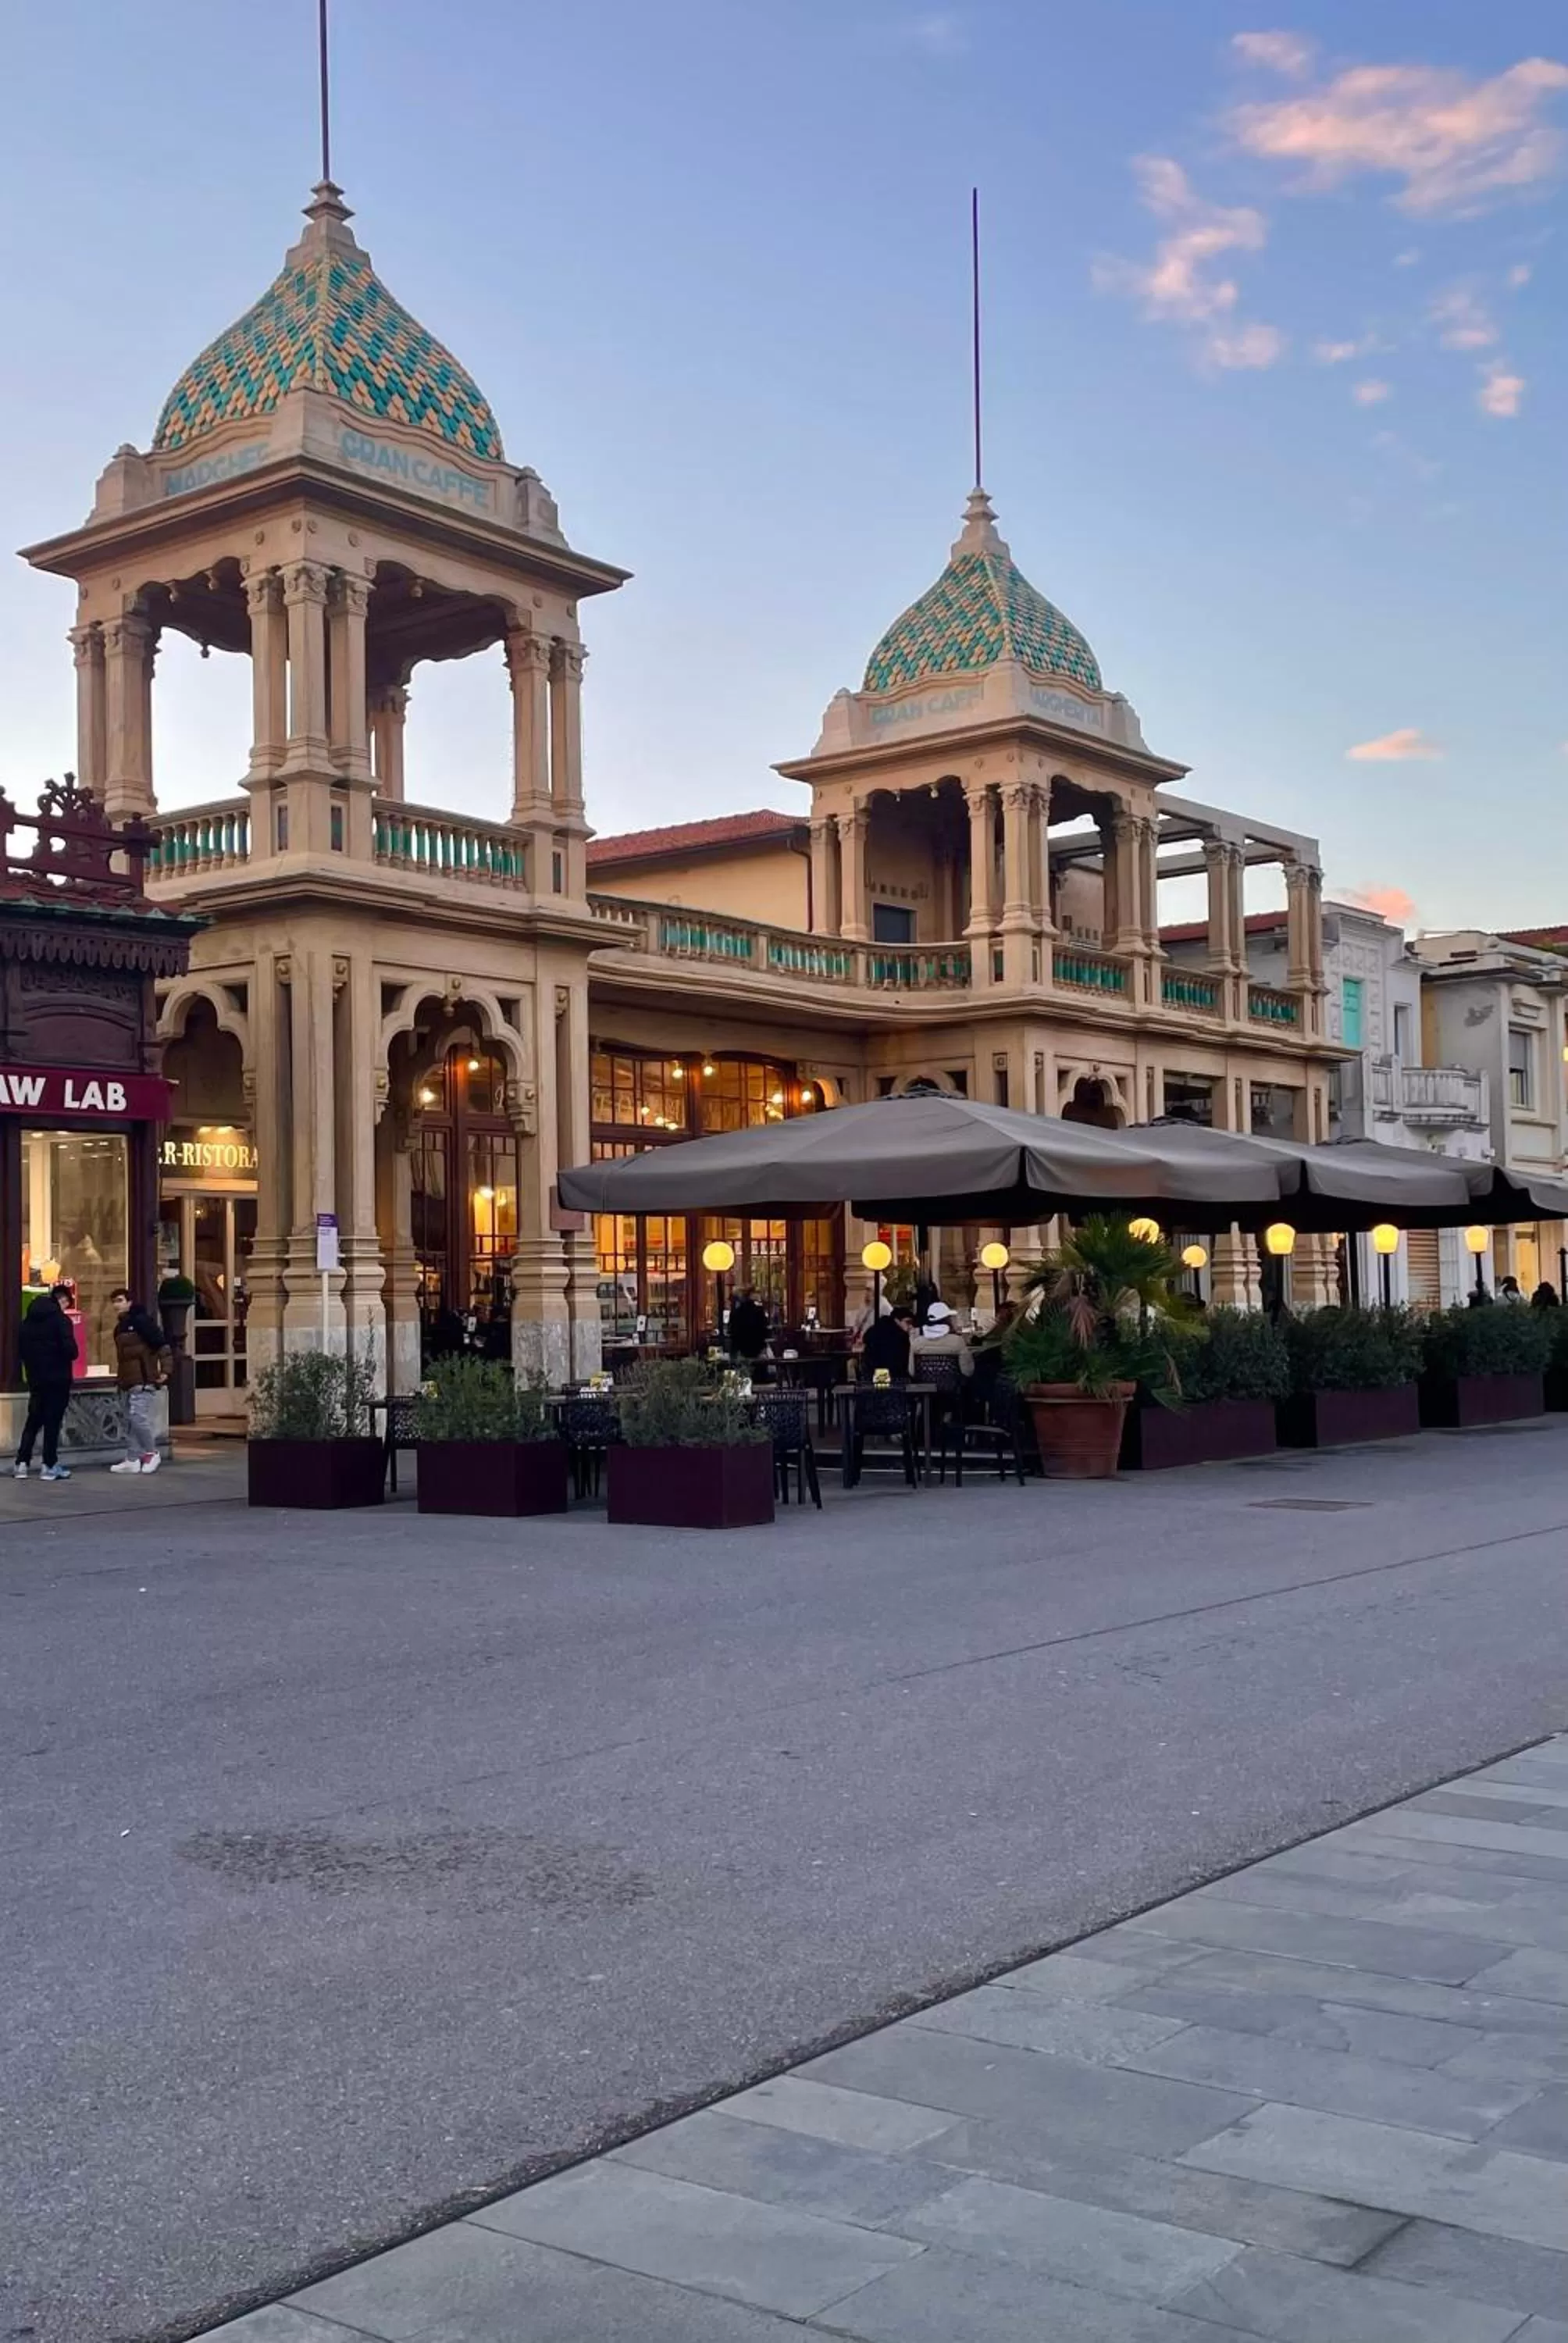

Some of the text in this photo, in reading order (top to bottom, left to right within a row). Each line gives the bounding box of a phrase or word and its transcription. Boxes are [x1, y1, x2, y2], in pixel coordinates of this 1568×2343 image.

[341, 431, 408, 479] GRAN
[64, 1079, 127, 1111] LAB
[158, 1141, 258, 1168] R-RISTORA
